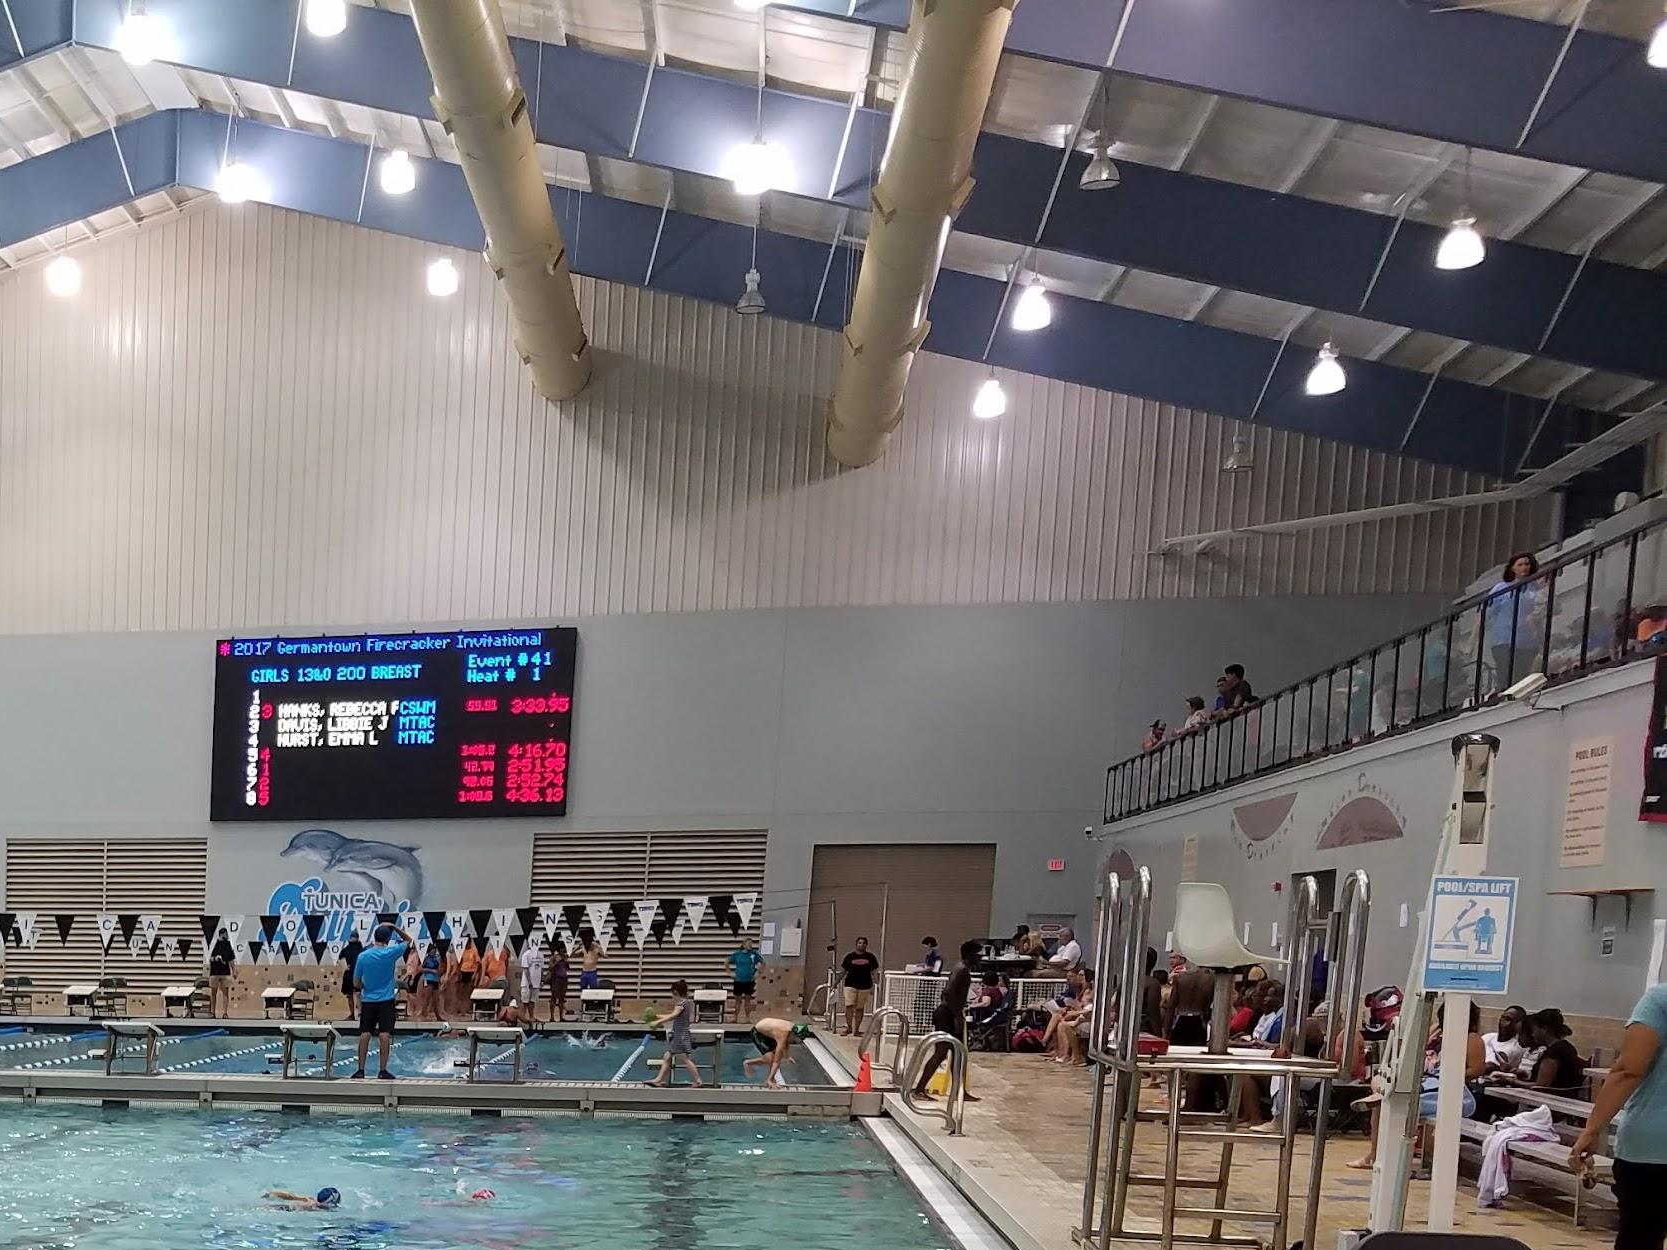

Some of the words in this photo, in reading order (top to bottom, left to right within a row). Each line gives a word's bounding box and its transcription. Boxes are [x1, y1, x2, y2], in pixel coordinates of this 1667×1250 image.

[234, 642, 272, 656] 2017
[277, 641, 360, 654] Germantown
[366, 636, 450, 652] Firecracker
[456, 632, 542, 648] Invitational
[468, 653, 512, 668] Event
[251, 668, 289, 682] GIRLS
[336, 666, 366, 680] 200
[371, 664, 422, 680] BREAST
[466, 669, 500, 682] Heat
[252, 690, 260, 704] 1
[249, 704, 260, 718] 2
[261, 704, 273, 719] 3
[278, 703, 325, 718] HANKS,
[329, 701, 387, 716] REBECCA
[400, 700, 436, 714] CSWM
[248, 720, 260, 733] 3
[278, 718, 324, 732] DAVIS,
[377, 716, 390, 730] J
[398, 716, 436, 730] MTAC
[247, 734, 259, 748] 4
[277, 732, 324, 748] HURST,
[328, 732, 366, 746] EMMA
[368, 732, 378, 746] L
[398, 731, 435, 745] MTAC
[247, 748, 259, 762] 5
[260, 748, 271, 762] 4
[508, 742, 566, 758] 4:16.70
[1590, 745, 1608, 759] RULES
[246, 763, 258, 777] 6
[260, 763, 270, 776] 1
[246, 777, 257, 791] 7
[259, 777, 270, 791] 2
[246, 791, 256, 806] 8
[1437, 881, 1490, 894] POOL/SPA
[1490, 883, 1512, 894] LIFT
[302, 893, 379, 911] TUNICA
[102, 920, 112, 930] C
[146, 920, 155, 931] A
[230, 922, 238, 932] D
[286, 920, 296, 932] O
[360, 920, 368, 930] L
[407, 917, 416, 928] P
[452, 916, 462, 928] H
[546, 913, 556, 924] N
